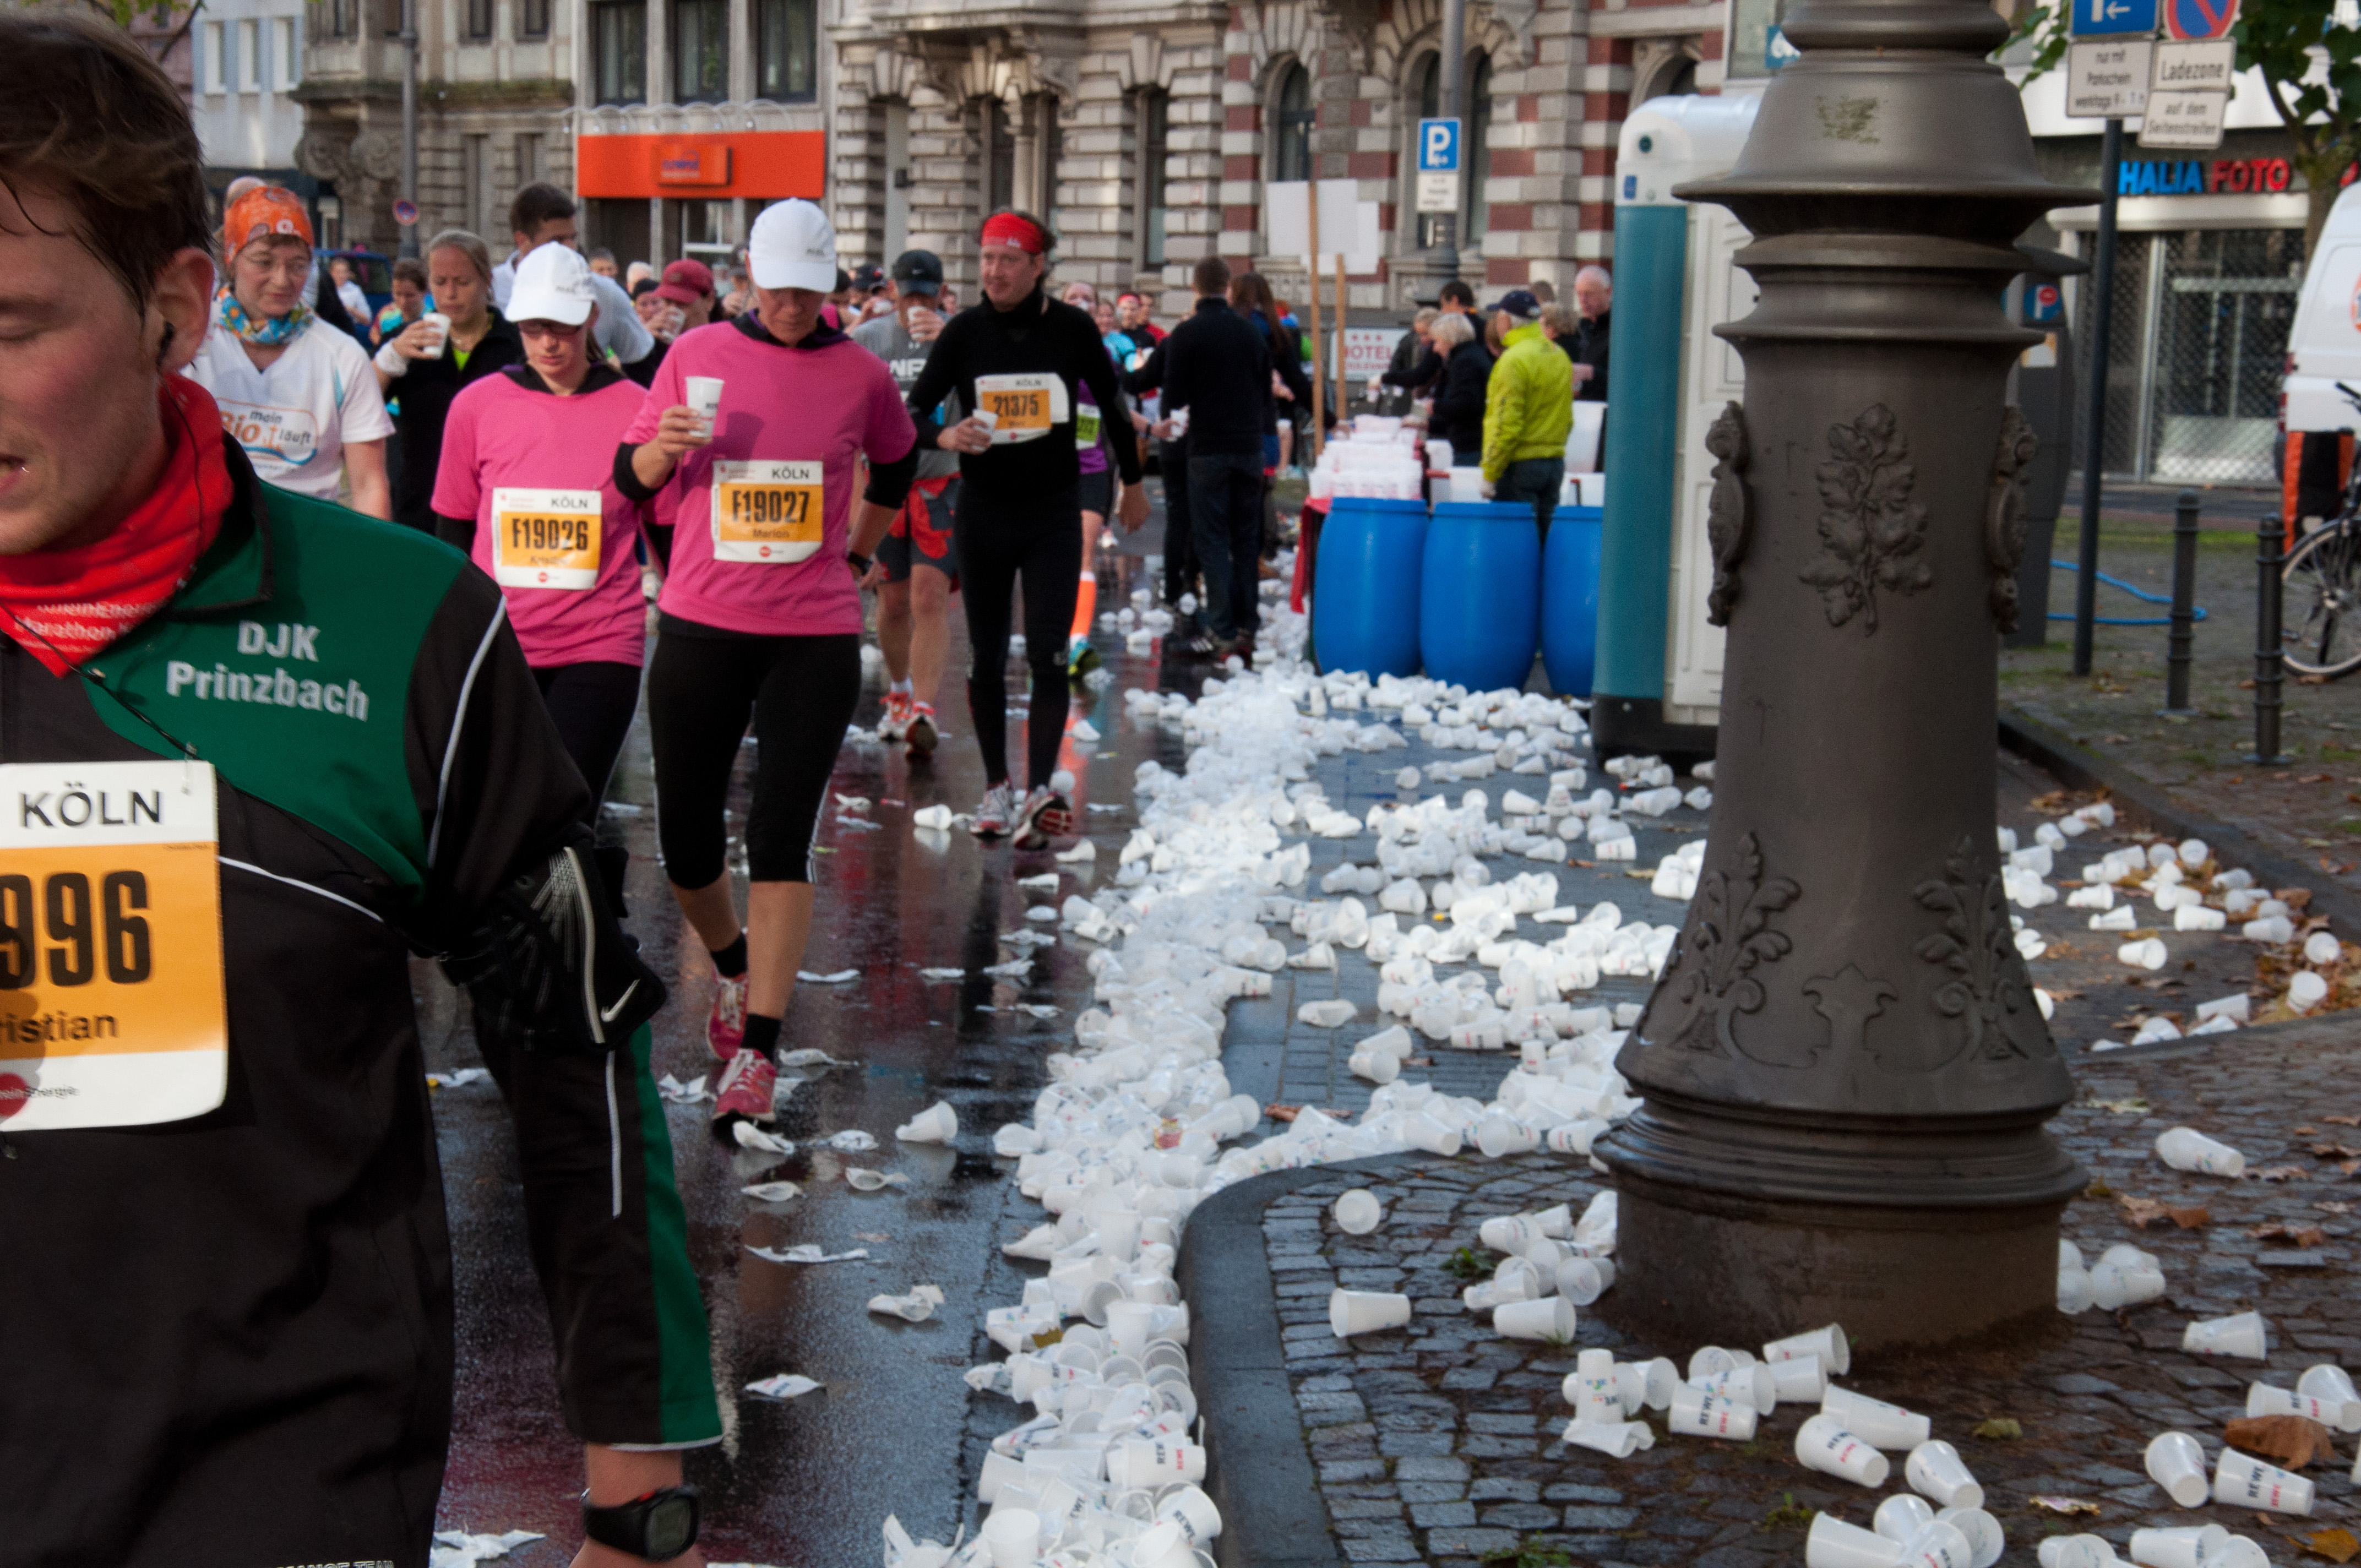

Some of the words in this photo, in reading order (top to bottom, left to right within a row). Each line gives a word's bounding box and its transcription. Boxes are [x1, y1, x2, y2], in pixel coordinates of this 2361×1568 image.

[2161, 59, 2223, 80] Ladezone
[2210, 157, 2289, 192] FOTO
[994, 394, 1038, 417] 21375
[279, 429, 311, 445] läuft
[772, 466, 809, 480] KÖLN
[551, 497, 588, 509] KÖLN
[733, 490, 810, 523] F19027
[512, 518, 589, 551] F19026
[753, 529, 790, 538] Marion
[237, 620, 321, 662] DJK
[166, 660, 369, 722] Prinzbach
[19, 781, 162, 829] KÖLN
[0, 869, 152, 989] 996
[2247, 1465, 2266, 1498] REWE
[1173, 1509, 1196, 1537] REWE
